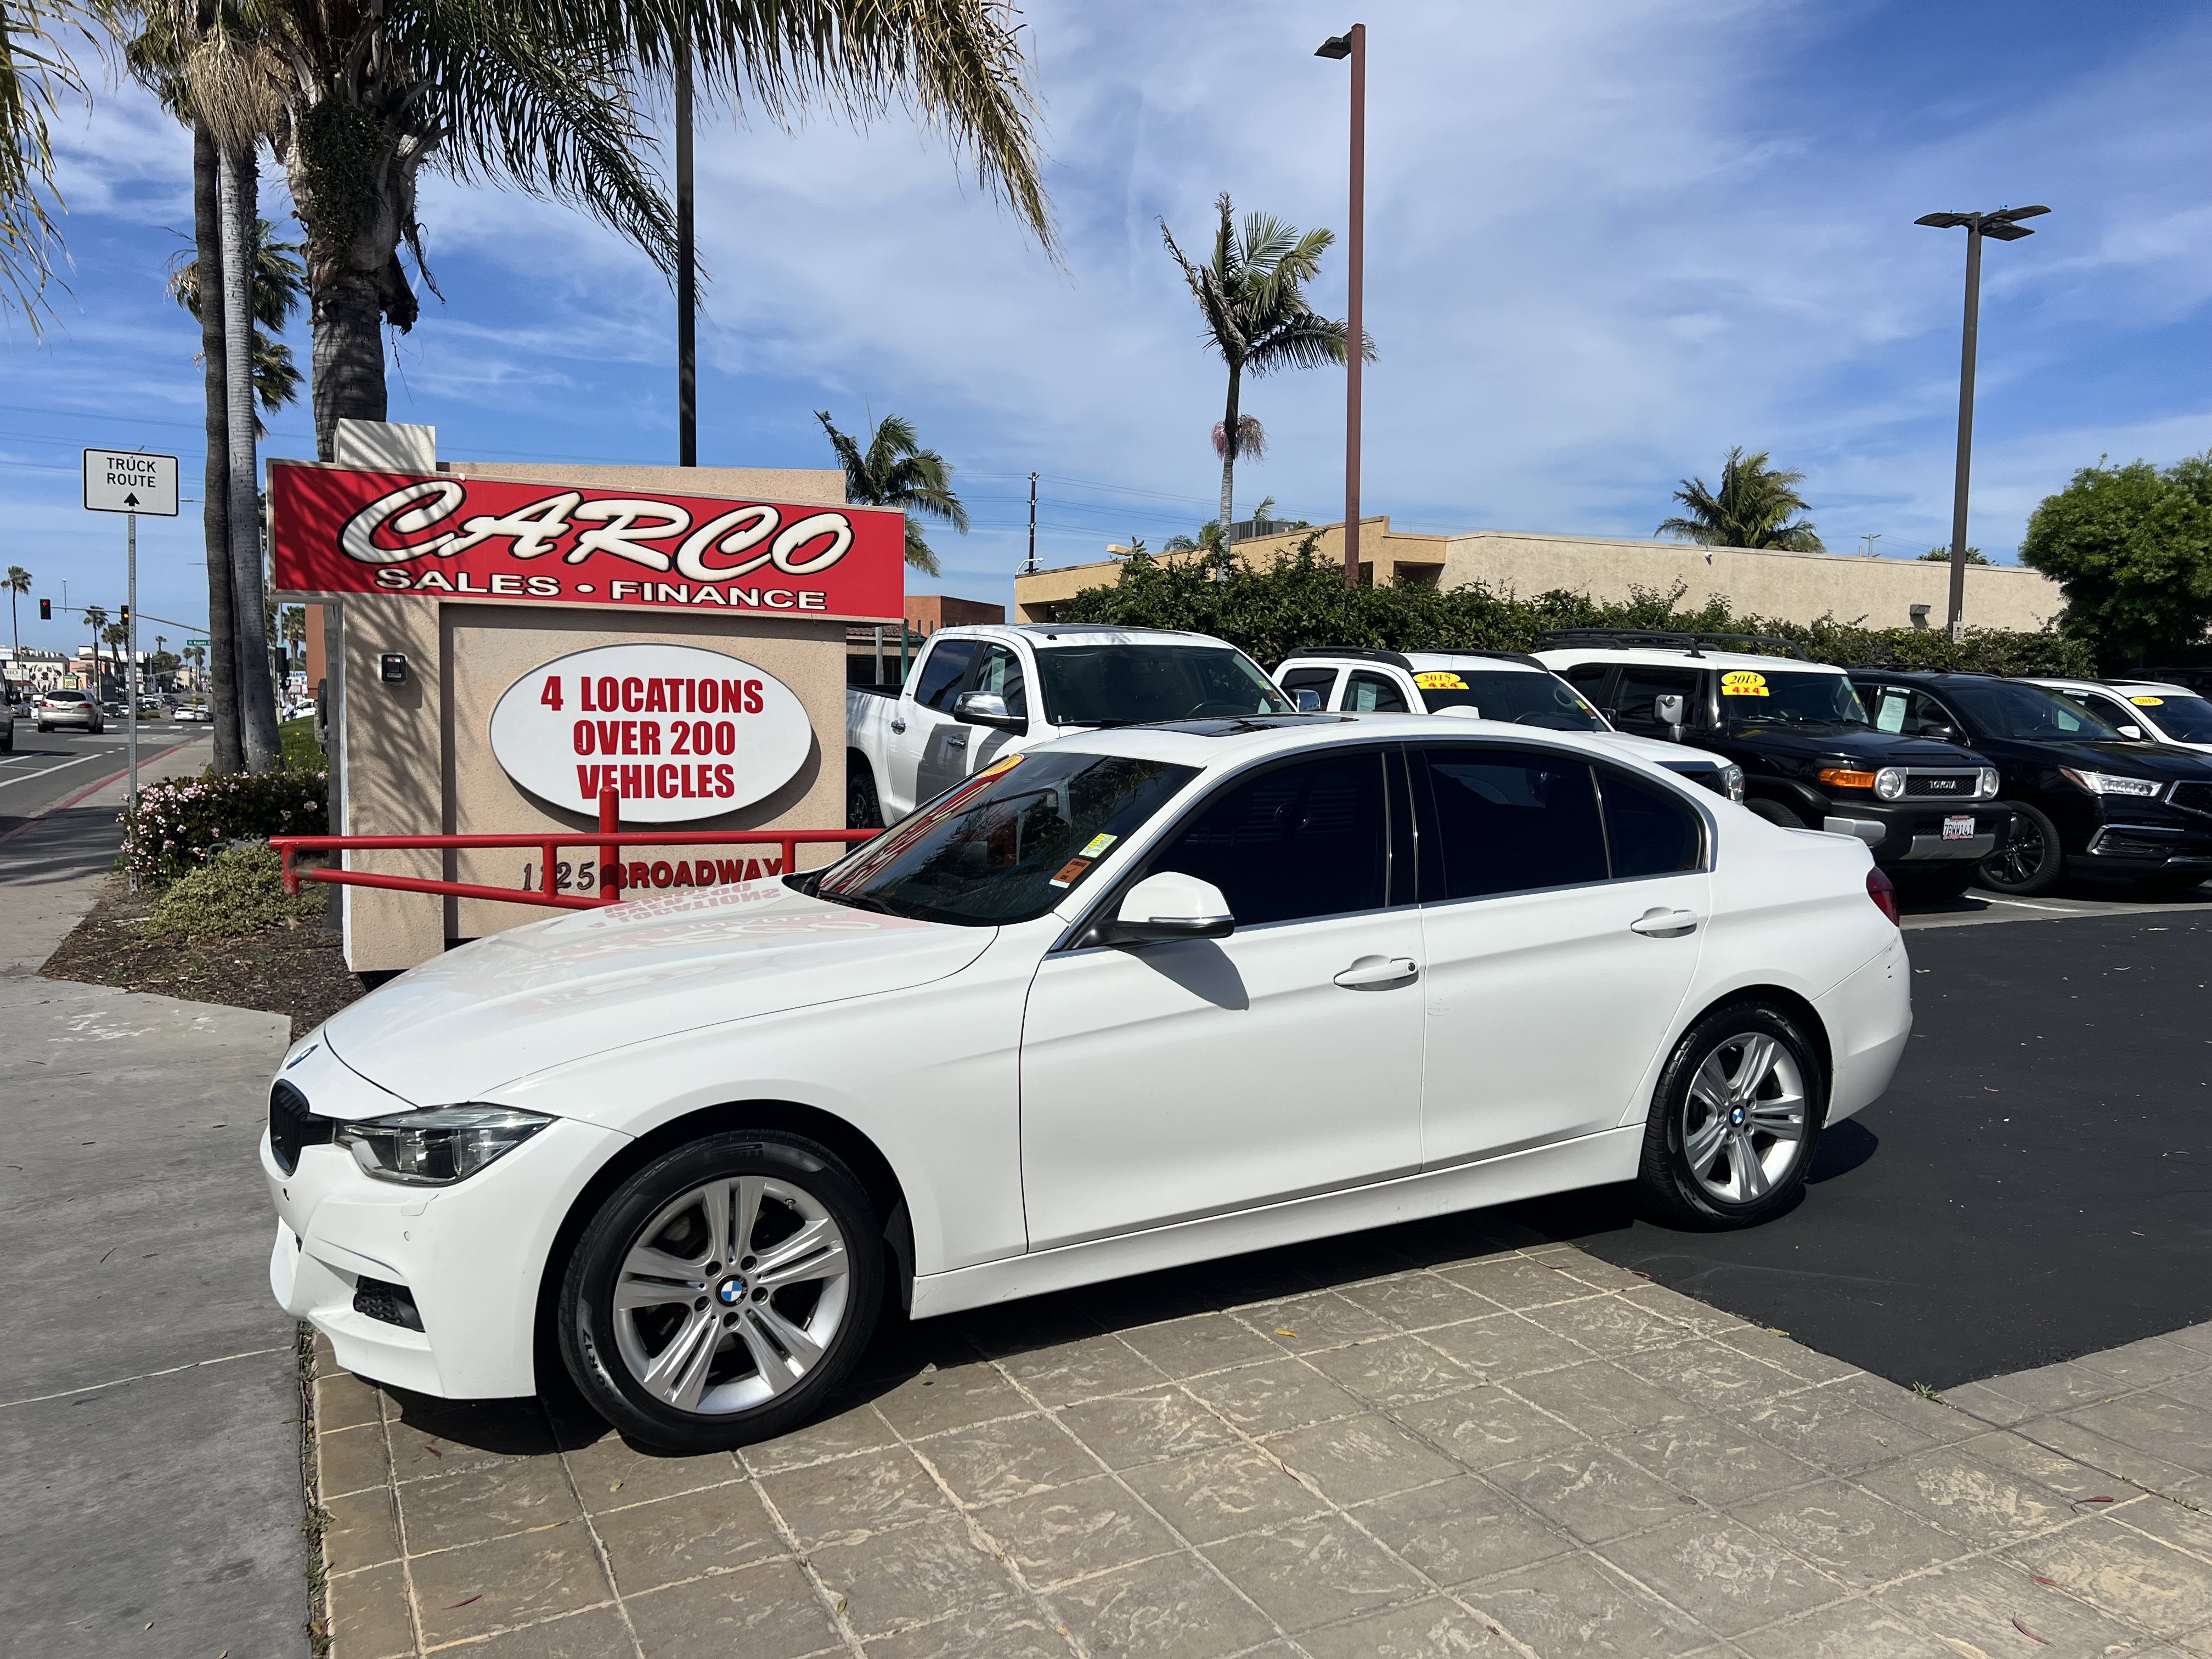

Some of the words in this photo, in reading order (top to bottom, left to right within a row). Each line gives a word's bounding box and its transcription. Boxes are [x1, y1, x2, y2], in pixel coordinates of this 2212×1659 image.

[106, 457, 156, 473] TRUCK
[107, 472, 156, 488] ROUTE
[338, 480, 854, 582] CARCO
[376, 568, 560, 596] SALES
[611, 580, 826, 610] FINANCE
[540, 676, 563, 711] 4
[580, 676, 764, 714] LOCATIONS
[1729, 675, 1758, 684] 2013
[573, 720, 661, 755] OVER
[670, 720, 735, 755] 200
[577, 764, 735, 799] VEHICLES
[1929, 781, 1956, 789] TOYOTA
